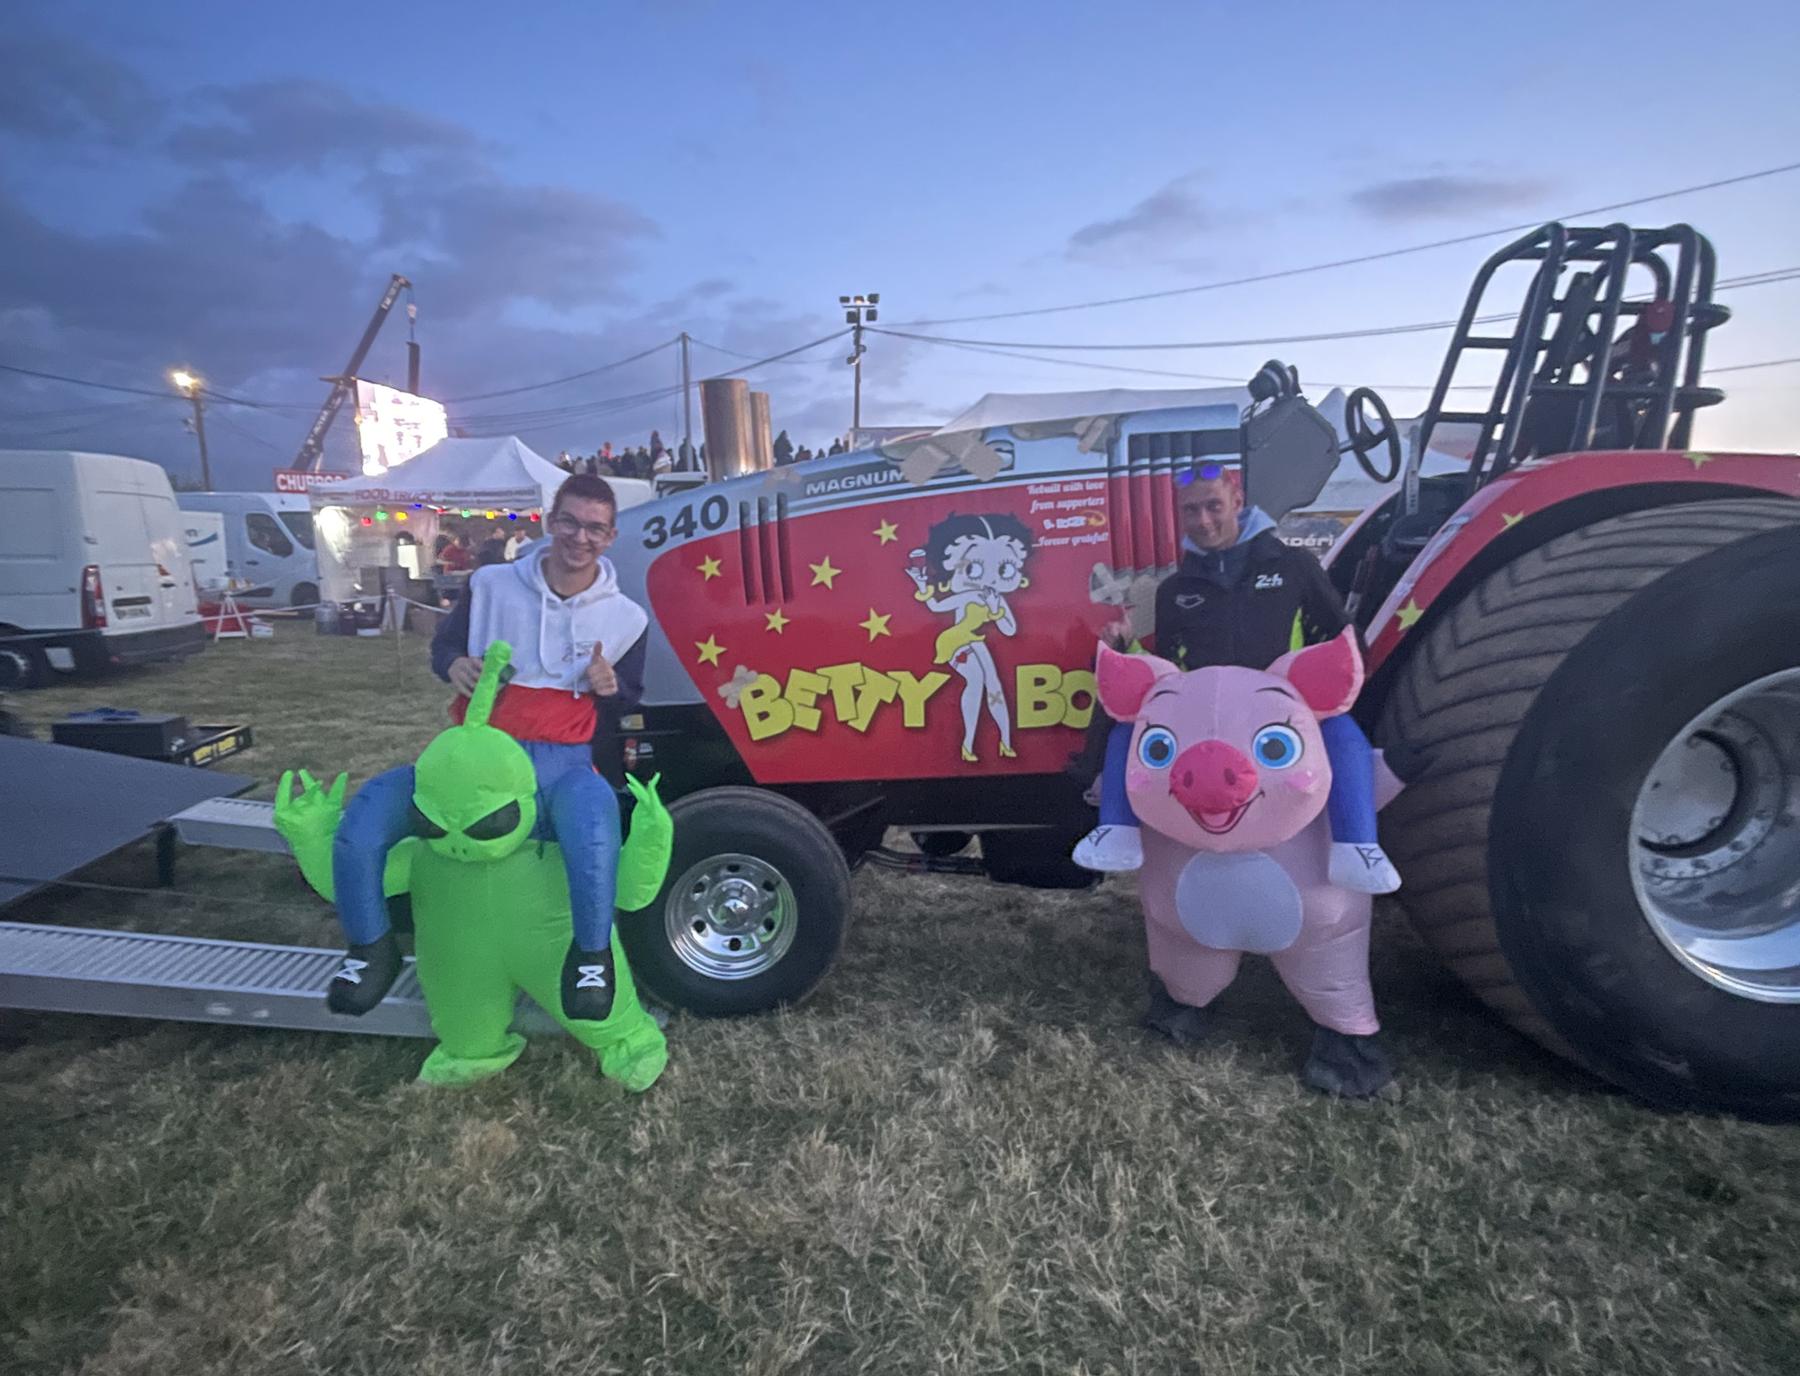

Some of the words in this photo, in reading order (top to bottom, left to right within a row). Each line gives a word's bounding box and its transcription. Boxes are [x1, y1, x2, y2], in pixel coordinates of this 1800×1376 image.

[276, 474, 343, 491] CHURRO
[805, 468, 906, 495] MAGNUM
[1062, 481, 1084, 492] with
[1085, 480, 1105, 490] love
[1030, 500, 1055, 514] from
[1056, 497, 1105, 511] supporters
[642, 494, 730, 549] 340
[739, 662, 952, 742] BETTY
